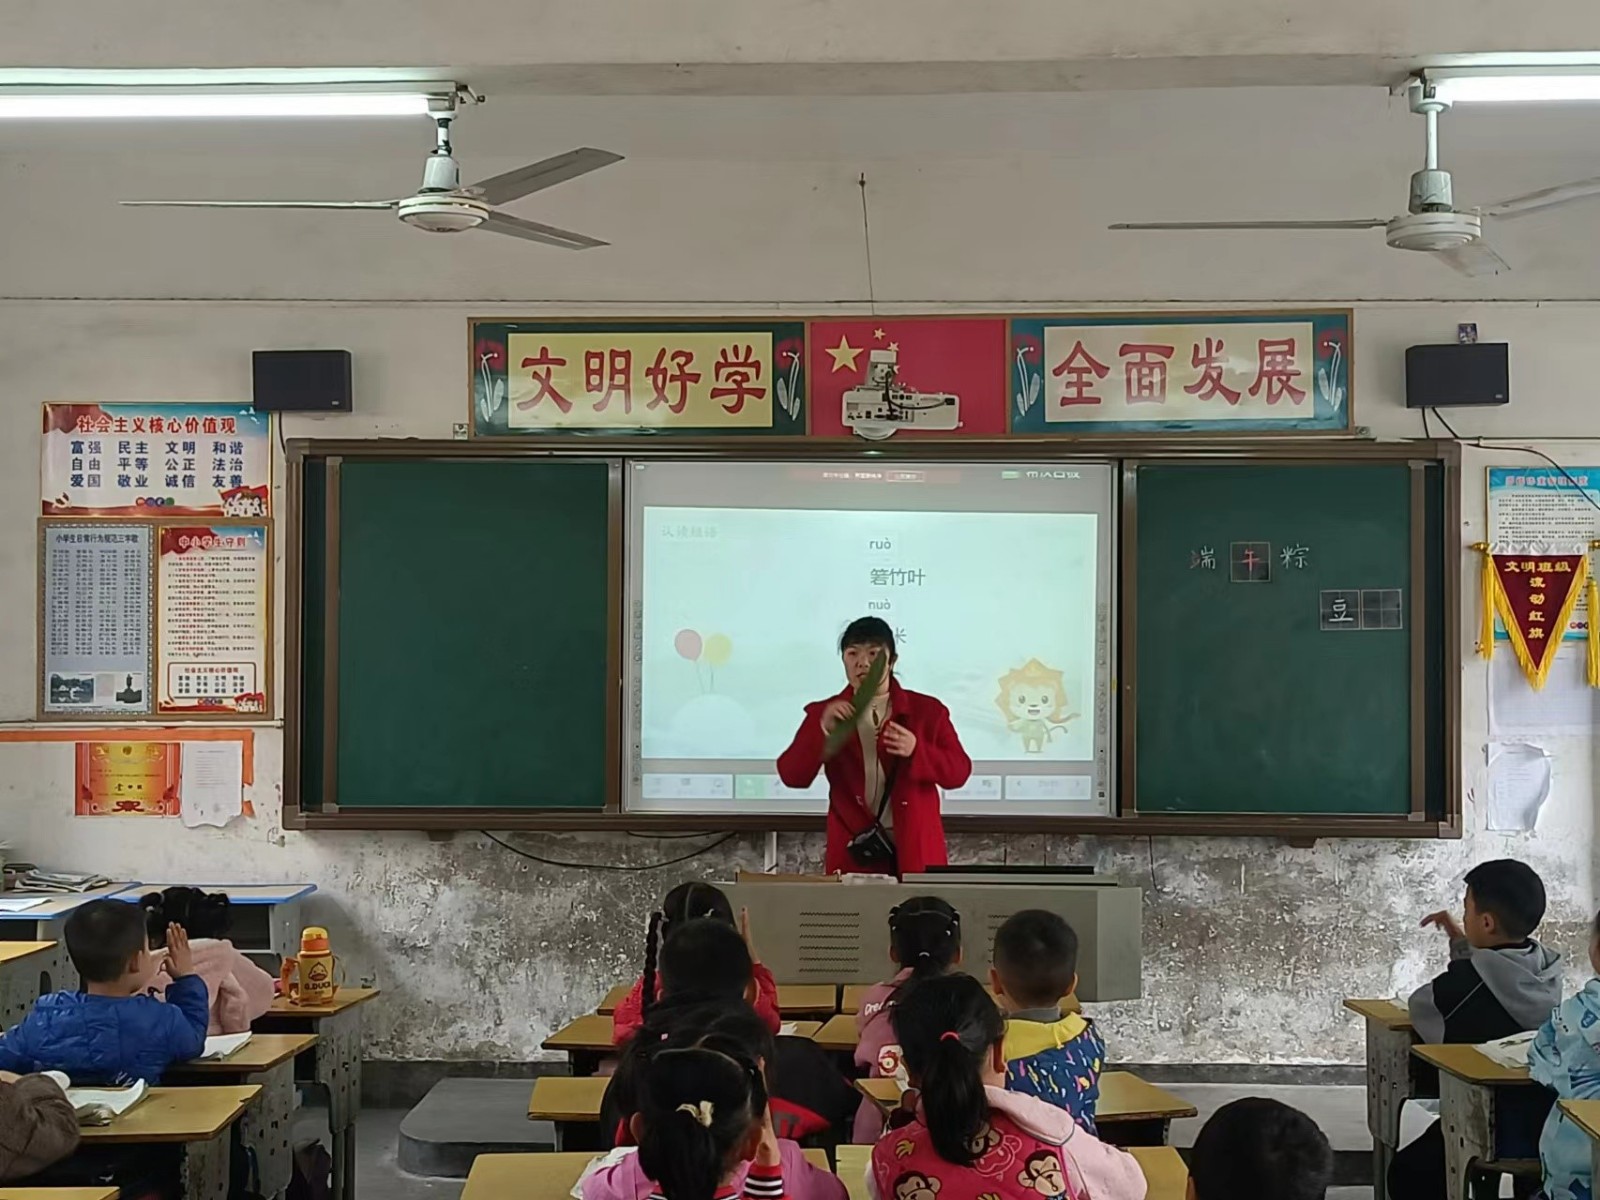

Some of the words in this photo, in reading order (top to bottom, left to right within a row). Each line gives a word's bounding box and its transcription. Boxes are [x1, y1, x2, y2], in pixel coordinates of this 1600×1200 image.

[515, 343, 767, 415] 文明好学
[1052, 337, 1307, 408] 全面发展
[77, 416, 237, 434] 社会主义核心价值观
[70, 440, 102, 455] 富强
[117, 440, 149, 455] 民主
[165, 440, 196, 455] 文明
[212, 440, 244, 455] 和谐
[70, 457, 102, 472] 自由
[117, 457, 149, 472] 平等
[165, 457, 196, 472] 公正
[212, 457, 244, 472] 法治
[70, 474, 102, 488] 爱国
[117, 474, 149, 488] 敬业
[165, 474, 196, 488] 诚信
[212, 474, 244, 488] 友善
[869, 537, 892, 549] ruò
[1504, 561, 1572, 574] 文明班级
[870, 568, 926, 586] 箬竹叶
[868, 598, 891, 610] nuò
